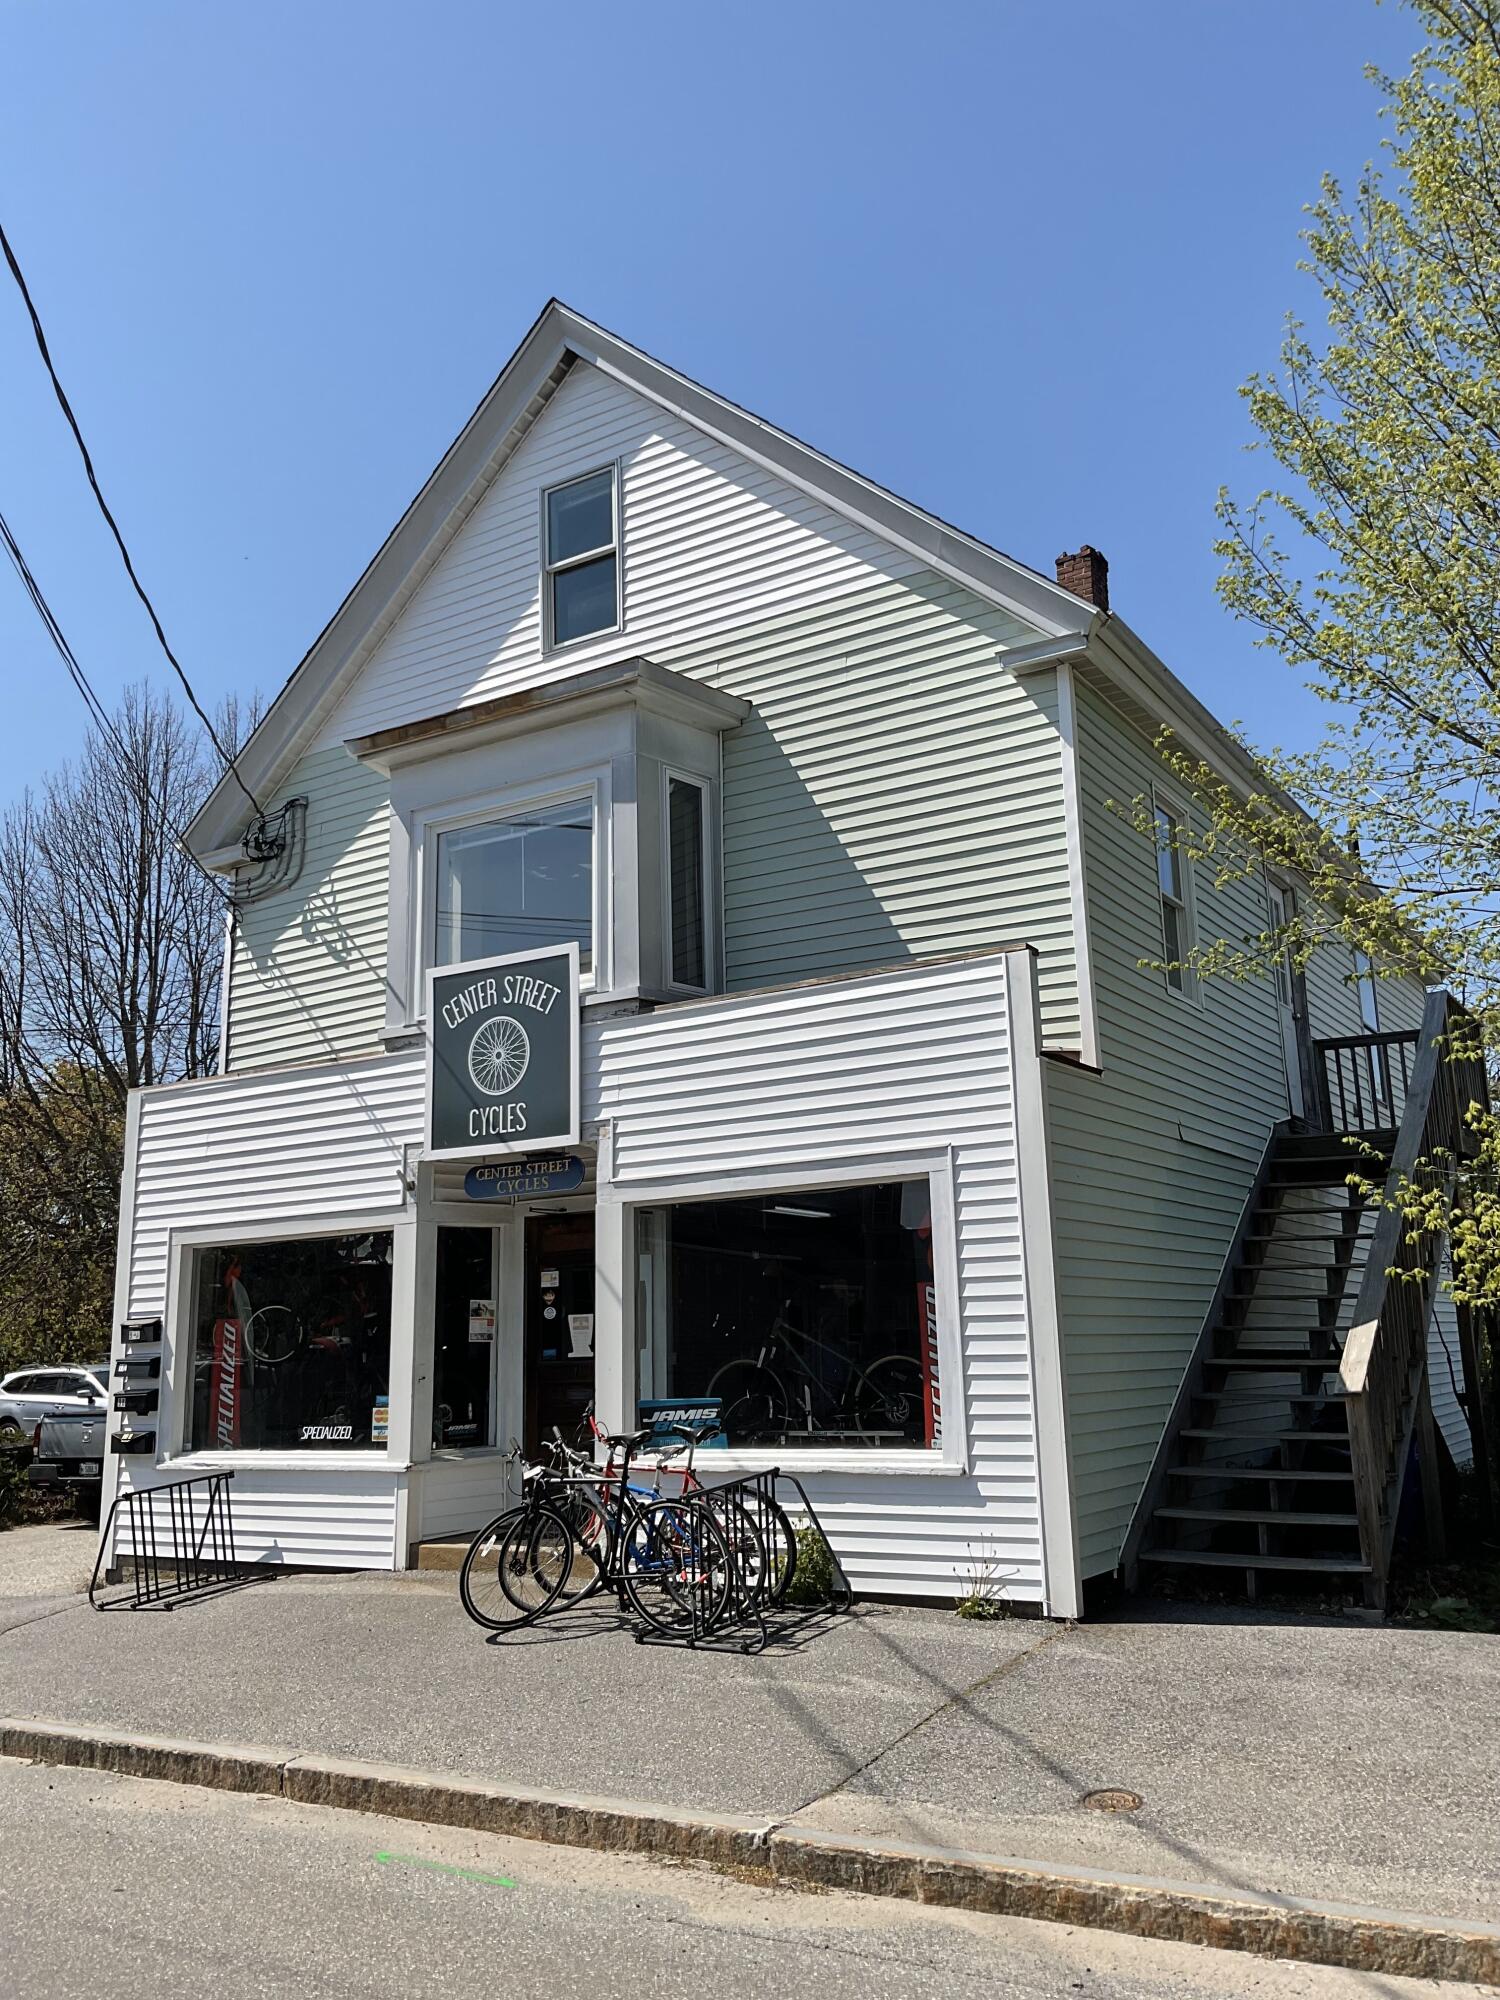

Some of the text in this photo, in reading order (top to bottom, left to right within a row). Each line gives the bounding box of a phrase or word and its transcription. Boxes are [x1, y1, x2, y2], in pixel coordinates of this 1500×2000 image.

[442, 975, 562, 1029] CENTER STREET
[469, 1102, 527, 1137] CYCLES
[475, 1159, 572, 1181] CENTER STREET
[496, 1176, 550, 1194] CYCLES
[642, 1408, 719, 1423] JAMIS
